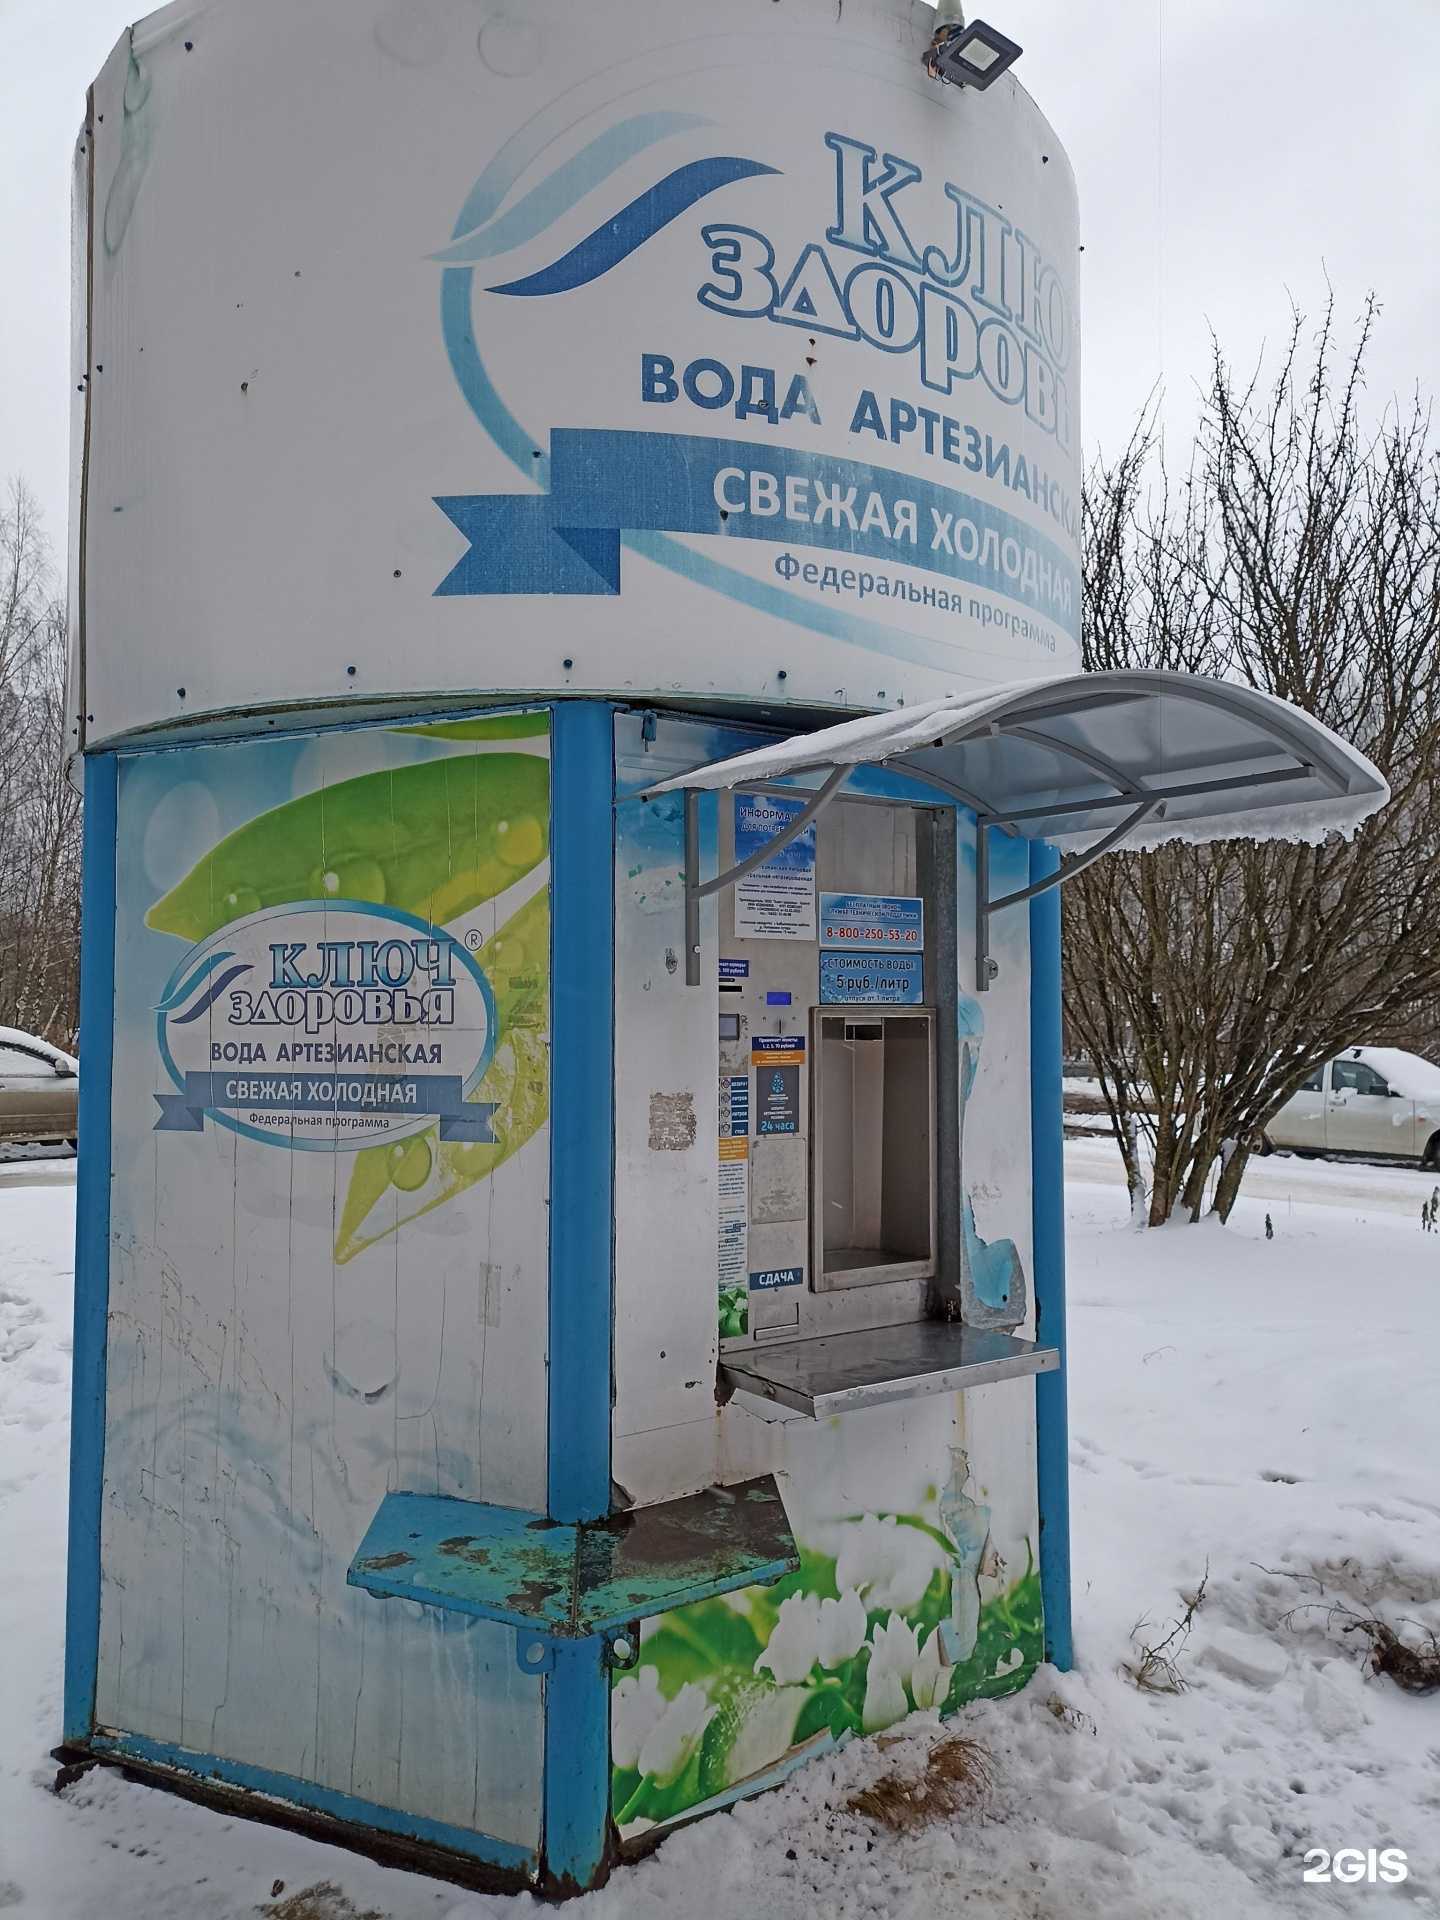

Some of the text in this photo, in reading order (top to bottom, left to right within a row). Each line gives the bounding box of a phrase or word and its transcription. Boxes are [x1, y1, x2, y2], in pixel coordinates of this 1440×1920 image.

[641, 353, 821, 425] ВОДА
[713, 466, 1072, 616] СВЕЖАЯ ХОЛОДНАЯ
[775, 552, 1056, 652] Федеральная программа
[826, 926, 918, 941] 8-800-250-53-20
[269, 938, 457, 989] КЛЮЧ
[827, 958, 914, 970] СТОИМОСТЬ ВОДЫ
[836, 974, 909, 992] 5 руб./литр
[229, 988, 455, 1034] ЗДОРОВЬЯ
[211, 1041, 442, 1064] ВОДА АРТЕЗИАНСКАЯ
[226, 1079, 417, 1106] СВЕЖАЯ ХОЛОДНАЯ
[249, 1111, 390, 1130] Федеральная программа
[760, 1121, 795, 1132] 24 часа
[759, 1271, 795, 1286] СДАЧА
